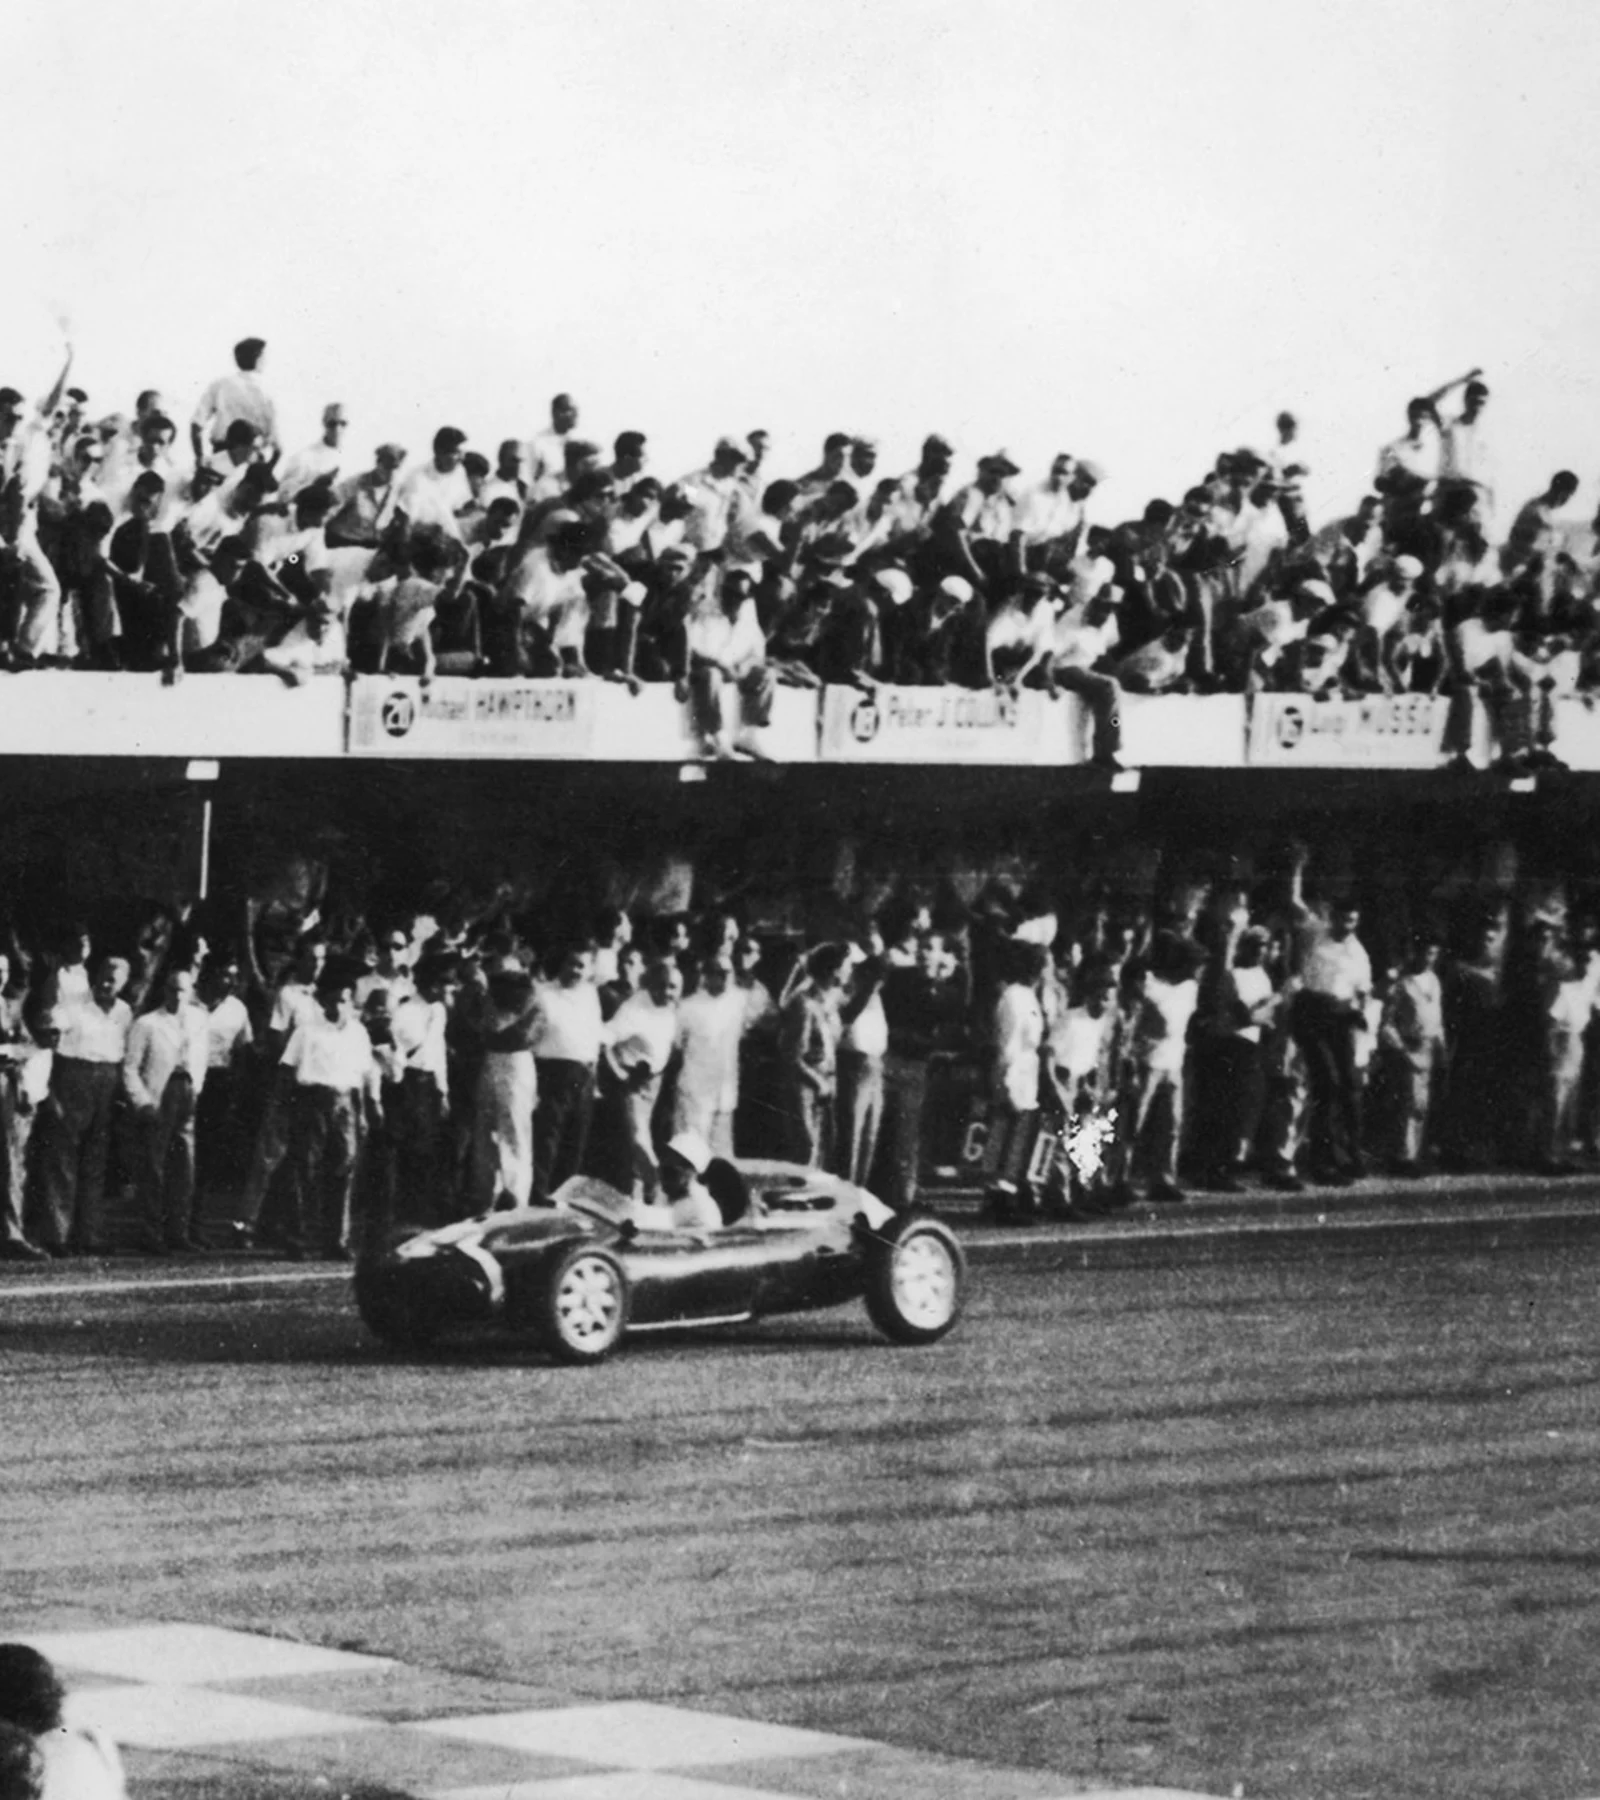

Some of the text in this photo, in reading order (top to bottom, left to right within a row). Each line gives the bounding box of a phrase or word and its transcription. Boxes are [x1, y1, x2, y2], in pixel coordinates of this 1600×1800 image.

[385, 697, 411, 729] 20
[888, 696, 932, 728] Peter
[1358, 703, 1431, 735] MUSSO
